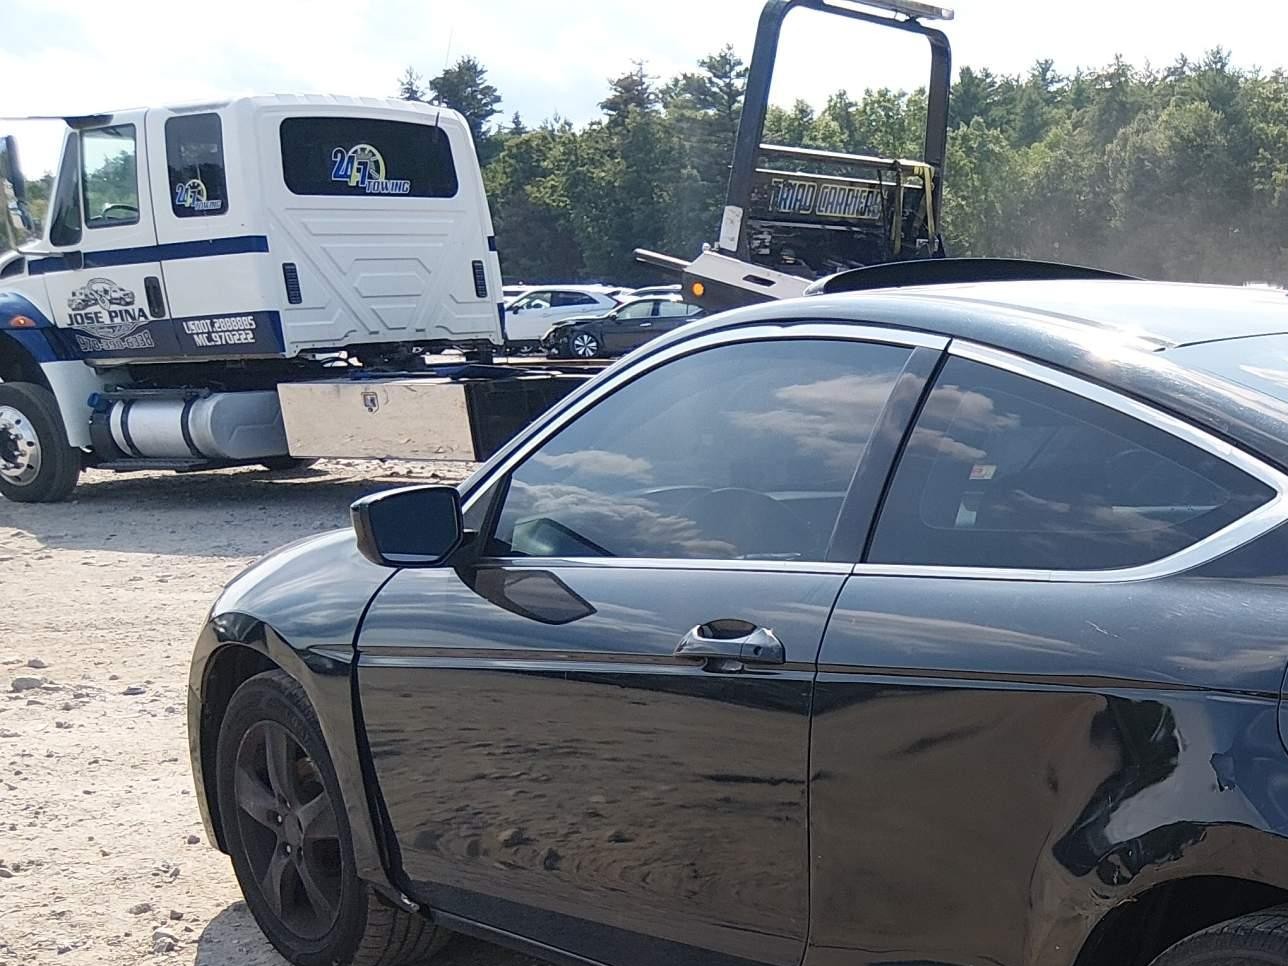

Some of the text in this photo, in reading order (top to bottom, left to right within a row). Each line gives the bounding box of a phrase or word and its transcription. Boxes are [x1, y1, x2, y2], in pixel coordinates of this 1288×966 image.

[365, 179, 411, 194] TOWING
[67, 307, 149, 326] JOSE PINA
[193, 330, 256, 347] MC.970222
